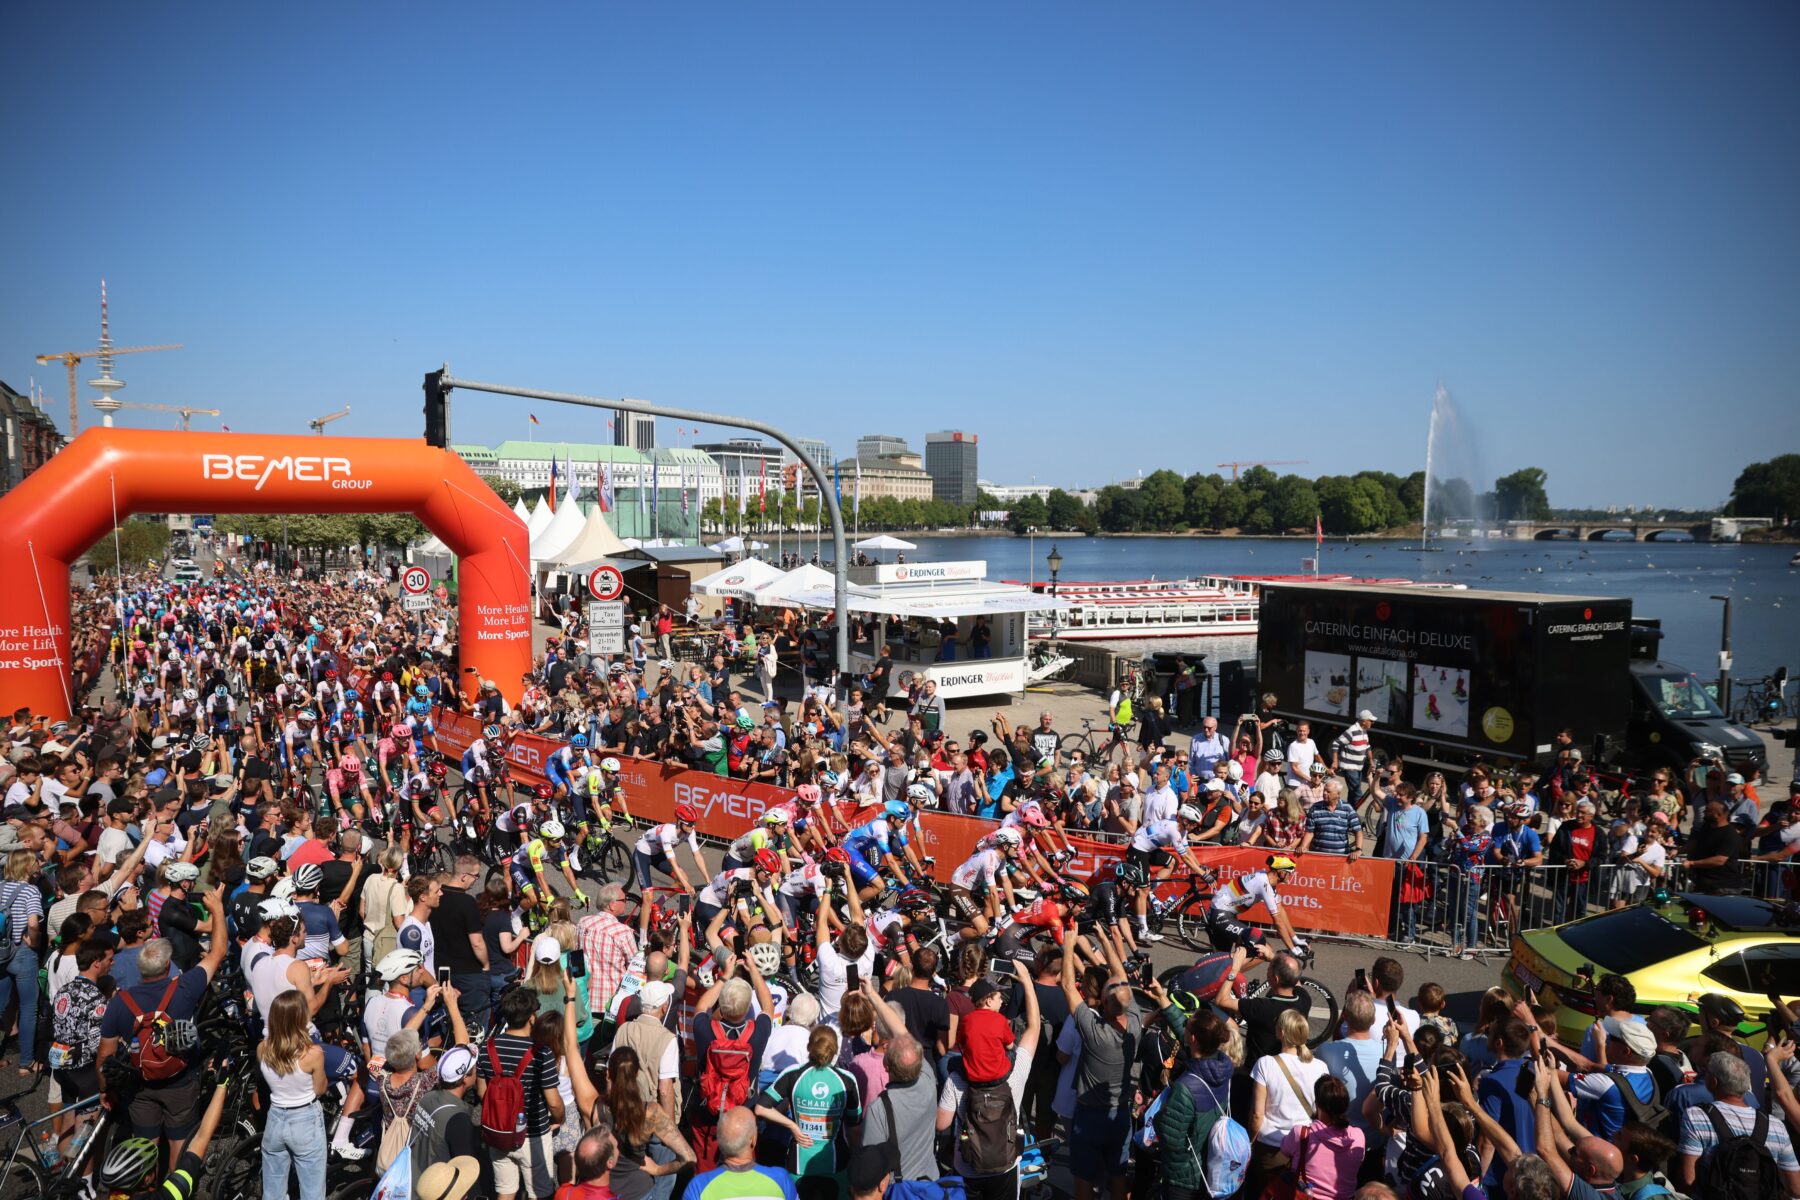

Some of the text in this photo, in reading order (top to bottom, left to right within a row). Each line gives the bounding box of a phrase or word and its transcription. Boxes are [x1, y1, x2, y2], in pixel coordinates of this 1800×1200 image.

[203, 454, 351, 491] BEMER
[332, 480, 373, 489] GROUP
[909, 568, 946, 577] ERDINGER
[408, 574, 425, 587] 30
[477, 606, 503, 615] More
[484, 617, 509, 626] More
[0, 628, 19, 637] ore
[1548, 624, 1577, 634] CATERING
[477, 631, 504, 640] More
[1305, 620, 1472, 650] CATERING EINFACH DELUXE
[0, 660, 20, 669] ore
[941, 674, 984, 687] ERDINGER
[675, 782, 766, 819] BEMER
[1330, 875, 1364, 893] Life.
[1274, 894, 1323, 909] ports.
[244, 906, 251, 914] N
[800, 1122, 823, 1131] 11341
